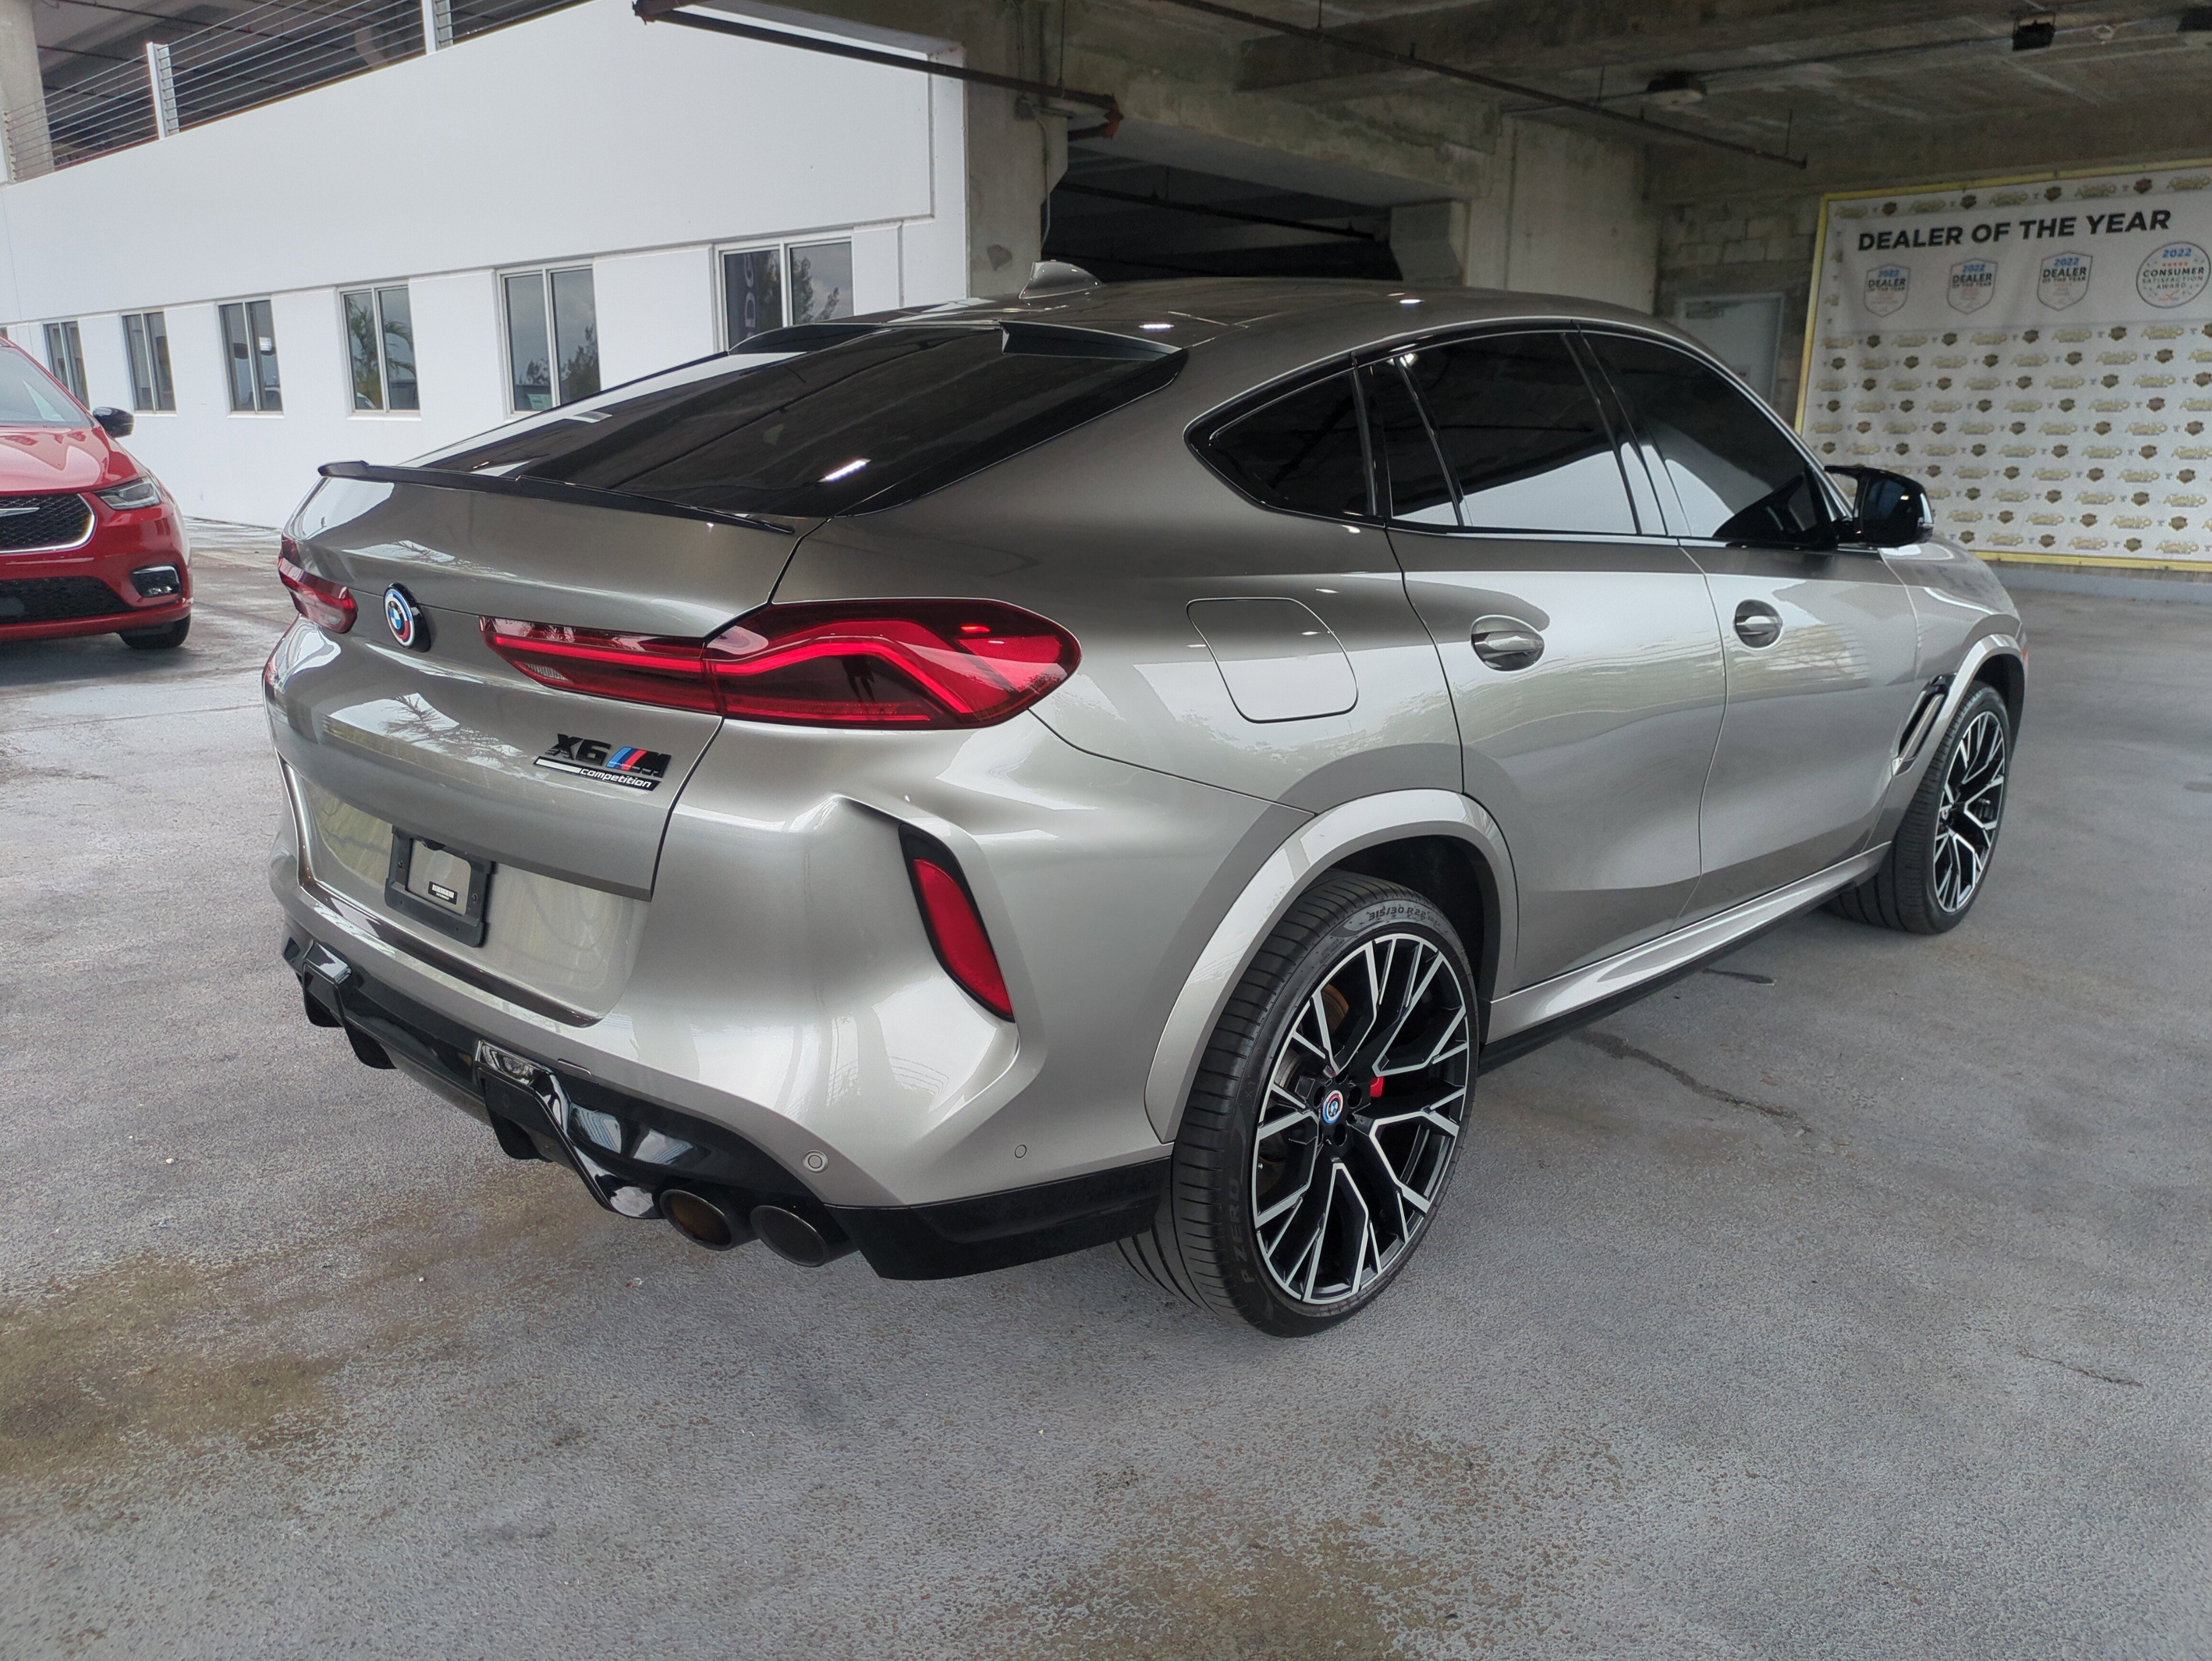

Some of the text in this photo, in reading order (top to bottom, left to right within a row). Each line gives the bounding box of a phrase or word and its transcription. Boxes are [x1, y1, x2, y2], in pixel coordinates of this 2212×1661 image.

[1858, 210, 2171, 251] DEALER OF THE YEAR
[2162, 248, 2192, 258] 2022
[2043, 266, 2086, 278] DEALER
[2143, 267, 2204, 277] CONSUMER
[1869, 278, 1906, 288] DEALER
[1953, 273, 1992, 283] DEALER
[580, 768, 652, 788] competition
[1368, 907, 1405, 921] 315/30
[1407, 907, 1427, 917] R22
